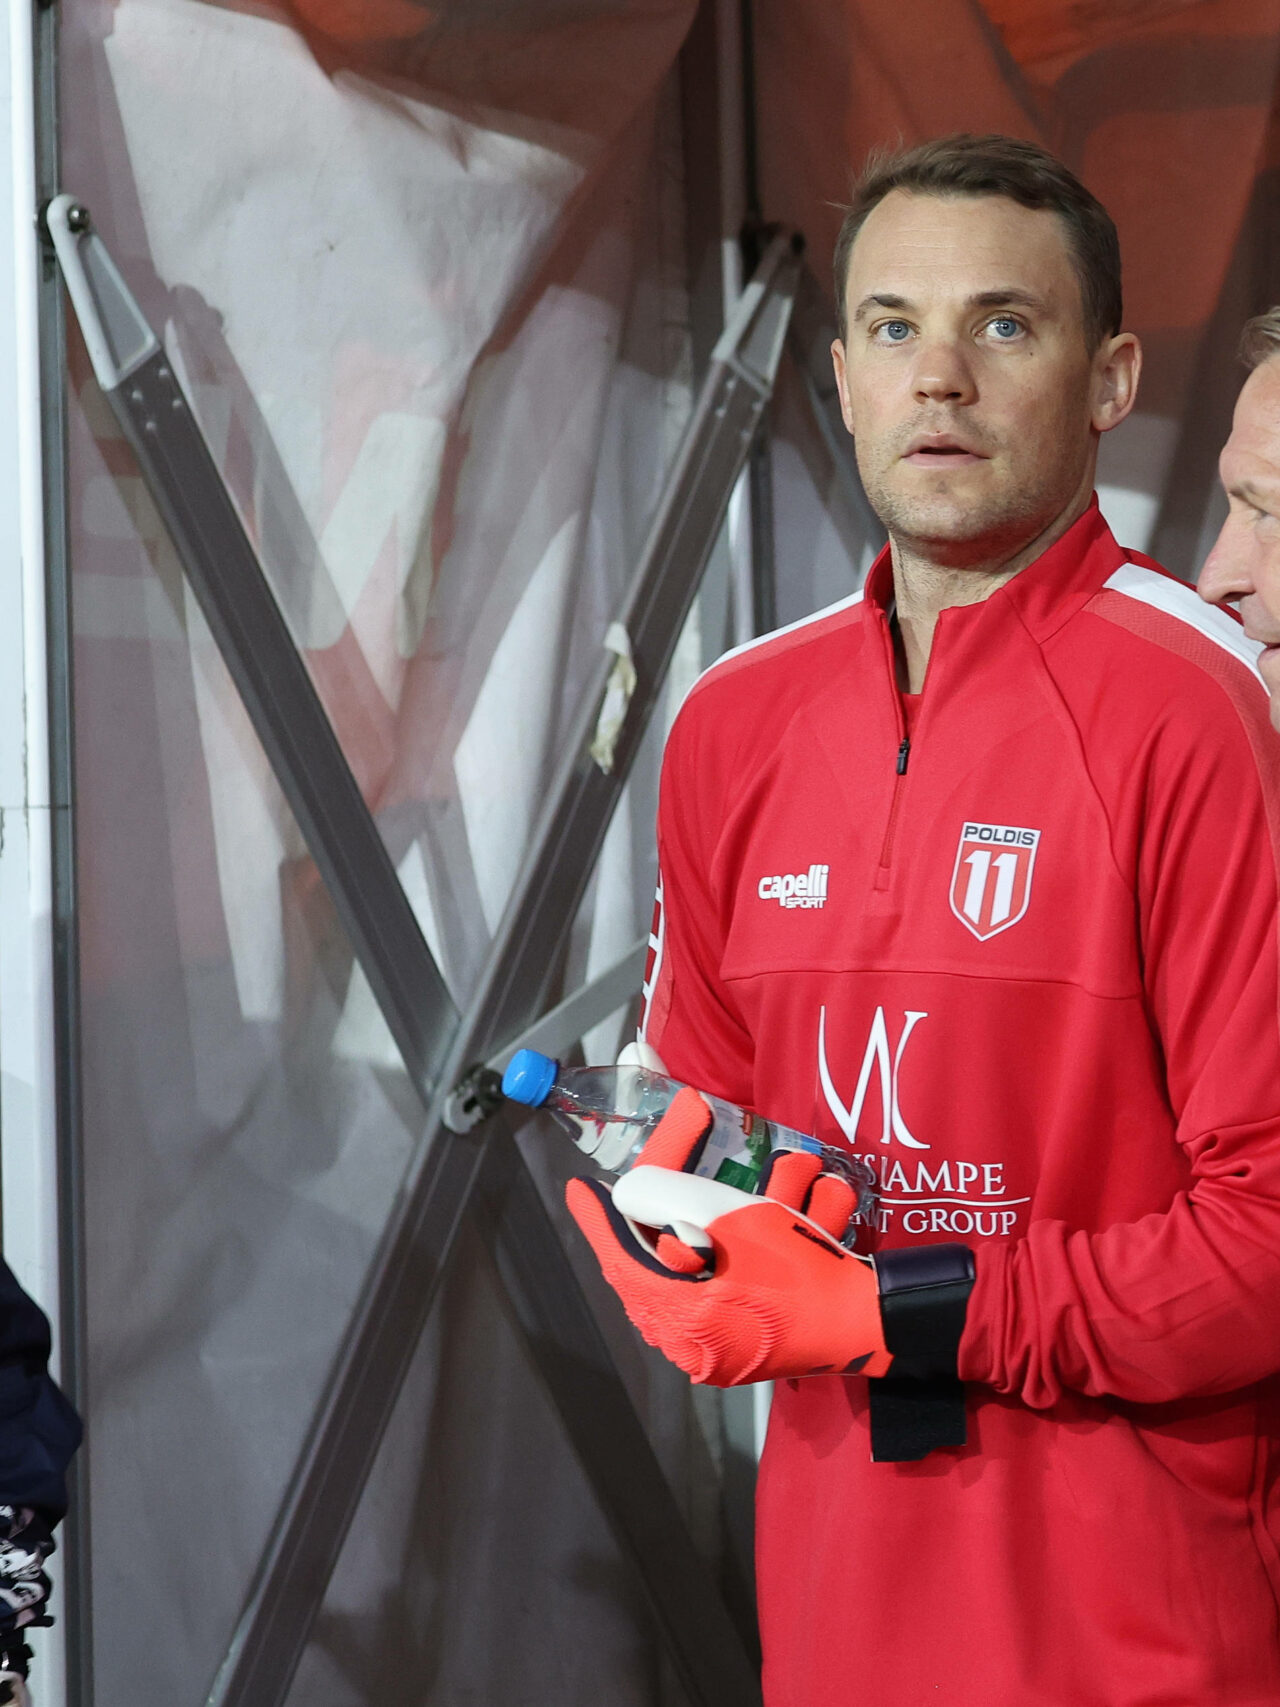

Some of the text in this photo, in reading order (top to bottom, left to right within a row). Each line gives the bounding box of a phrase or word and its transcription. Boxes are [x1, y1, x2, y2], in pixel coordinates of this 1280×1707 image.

[964, 825, 1036, 846] POLDIS
[758, 864, 829, 907] capelli
[963, 849, 1019, 927] 11
[785, 896, 827, 909] SPORT
[902, 1208, 1017, 1236] GROUP
